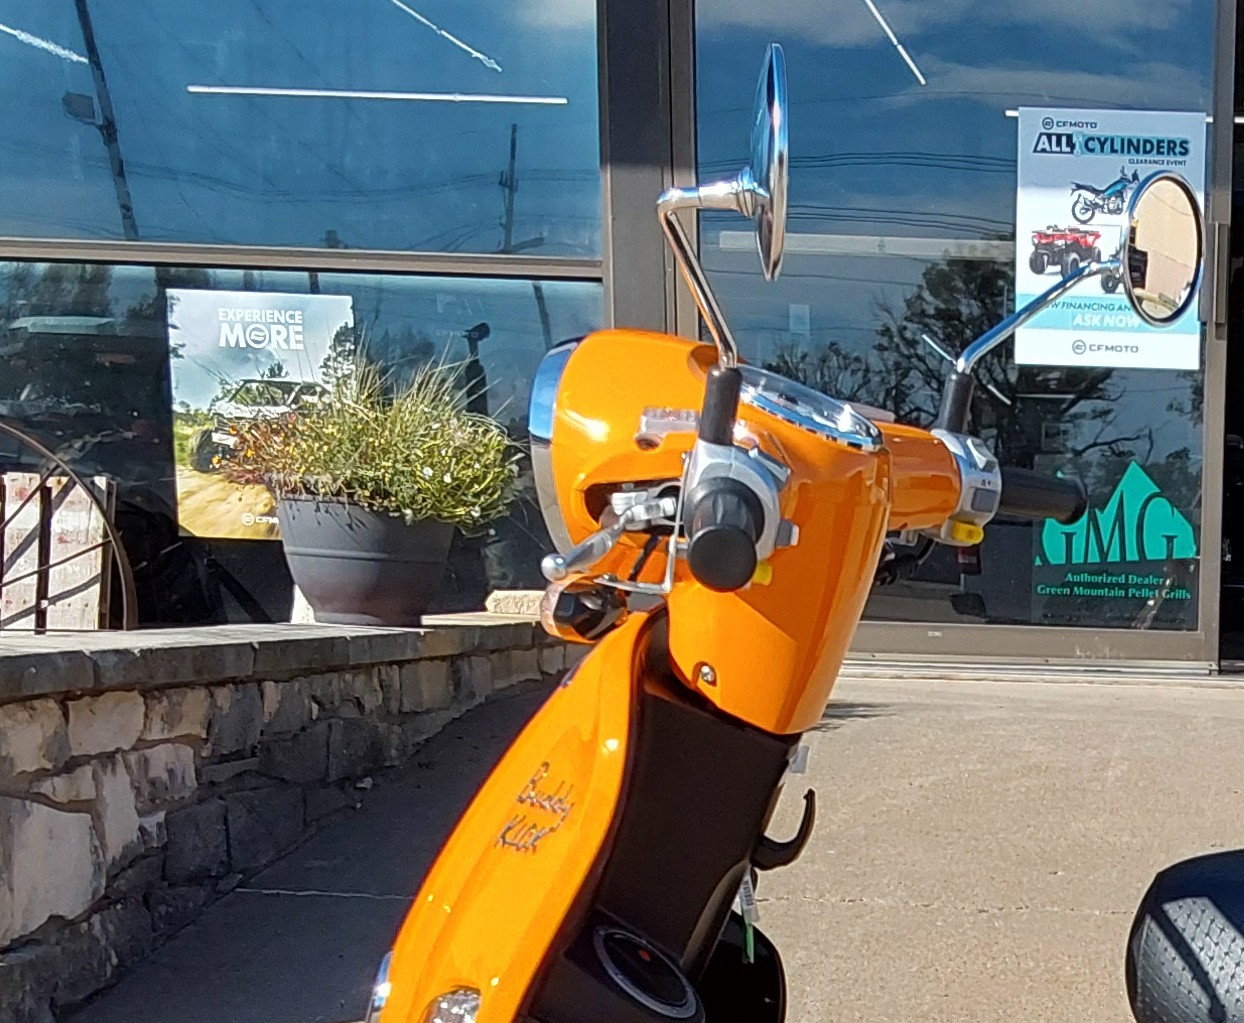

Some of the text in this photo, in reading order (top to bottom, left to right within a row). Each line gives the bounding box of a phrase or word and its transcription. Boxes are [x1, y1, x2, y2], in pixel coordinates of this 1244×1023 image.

[1056, 120, 1098, 129] CFMOTO
[1036, 134, 1190, 157] ALL CYLINDERS
[1128, 158, 1187, 167] CLEARANCE EVENT
[1061, 301, 1115, 312] FINANCING
[1117, 303, 1131, 312] AN
[218, 308, 303, 324] EXPERIENCE
[1072, 313, 1141, 328] ASK NOW
[219, 323, 304, 350] MORE
[1089, 344, 1139, 353] CFMOTO
[1065, 572, 1164, 585] Authorized Dealer
[1036, 584, 1192, 600] Green Mountain Pellet Grills
